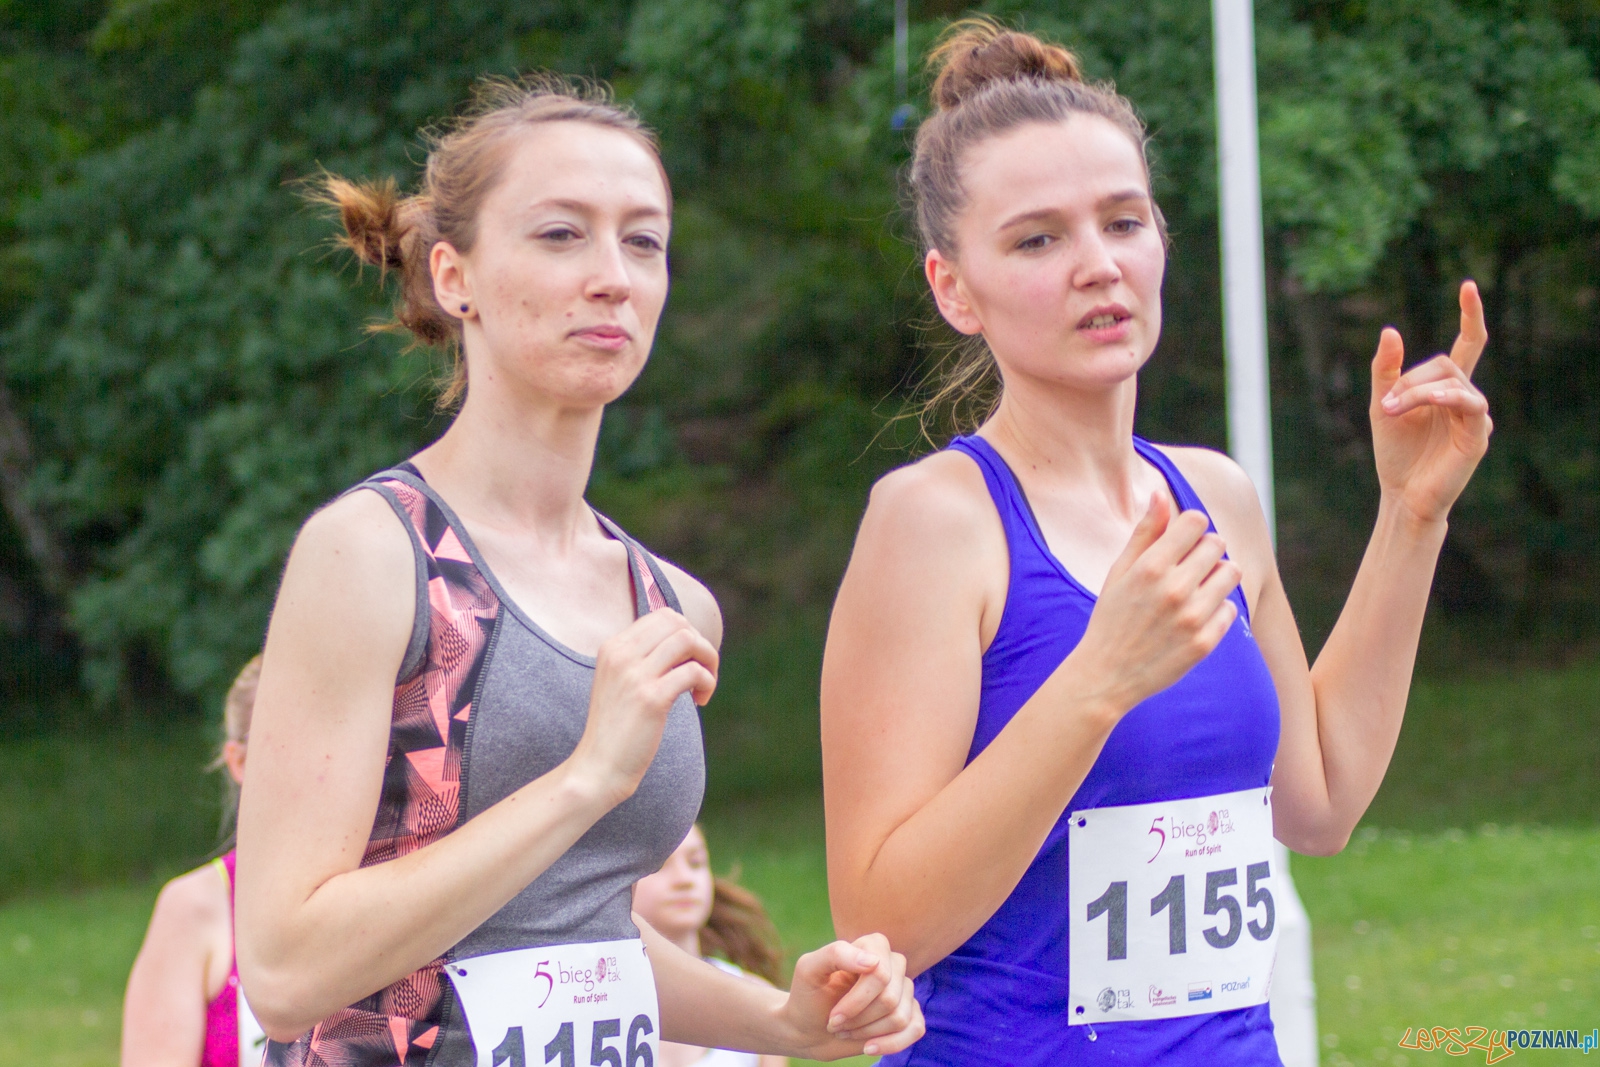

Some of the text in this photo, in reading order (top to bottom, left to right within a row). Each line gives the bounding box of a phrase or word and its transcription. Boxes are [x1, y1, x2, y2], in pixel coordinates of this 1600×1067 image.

[1218, 808, 1230, 819] na
[1220, 820, 1236, 834] tak
[1147, 816, 1207, 864] 5 bieg
[1185, 844, 1222, 858] Run of Spirit
[1087, 861, 1276, 961] 1155
[606, 956, 617, 967] na
[607, 969, 622, 982] tak
[534, 960, 595, 1009] 5 bieg
[573, 992, 608, 1004] Run of Spirit
[1117, 988, 1131, 998] na
[1117, 997, 1135, 1009] tak
[492, 1014, 654, 1067] 1156
